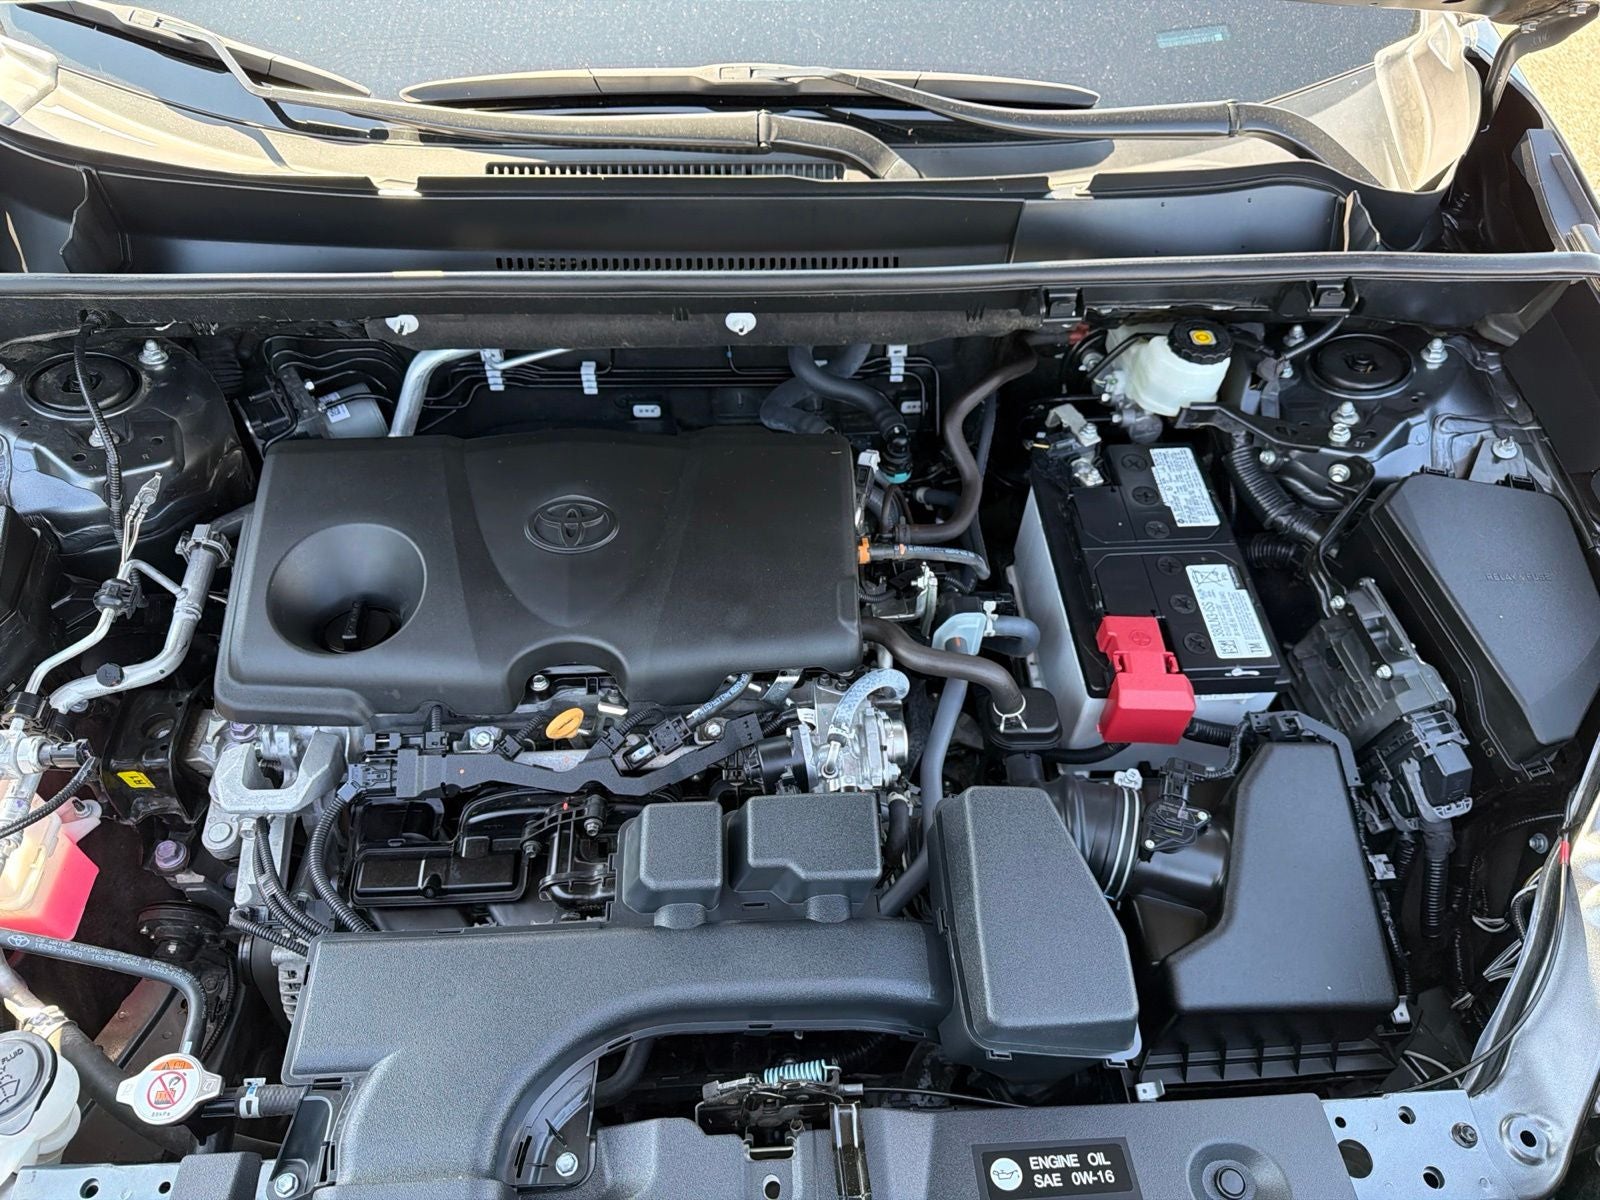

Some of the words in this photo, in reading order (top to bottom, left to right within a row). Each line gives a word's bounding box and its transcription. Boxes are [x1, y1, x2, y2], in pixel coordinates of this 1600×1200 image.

[1028, 1153, 1080, 1170] ENGINE
[1087, 1151, 1112, 1167] OIL
[1033, 1172, 1064, 1188] SAE
[1071, 1169, 1116, 1186] 0W-16
